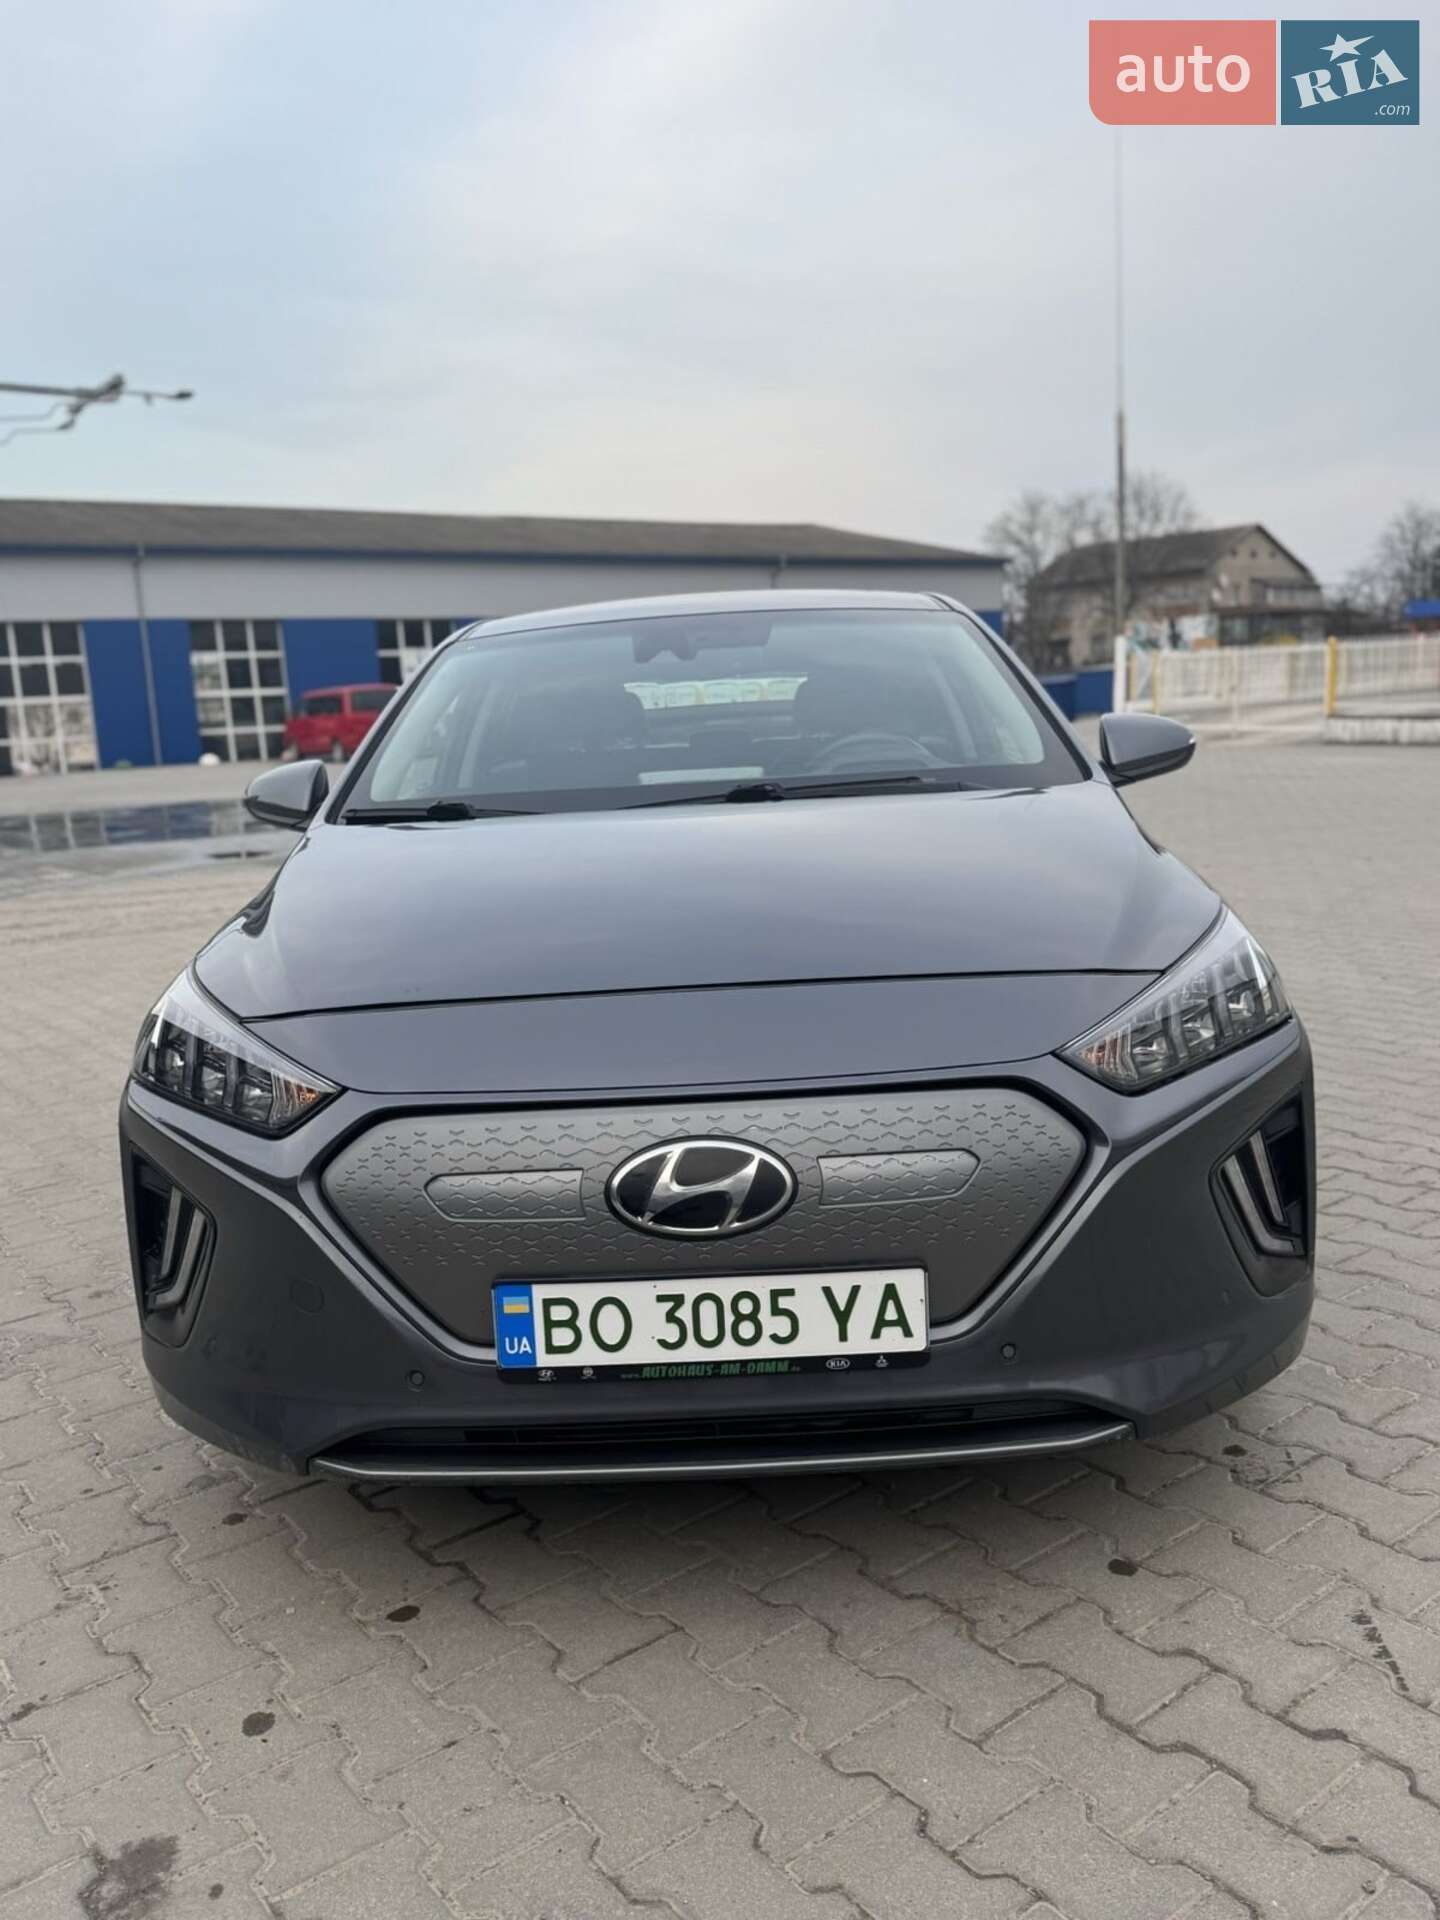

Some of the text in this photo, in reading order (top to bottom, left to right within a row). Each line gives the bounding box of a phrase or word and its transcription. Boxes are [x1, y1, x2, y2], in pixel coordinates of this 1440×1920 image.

[541, 1283, 914, 1355] BO 3085 YA
[505, 1337, 532, 1355] UA
